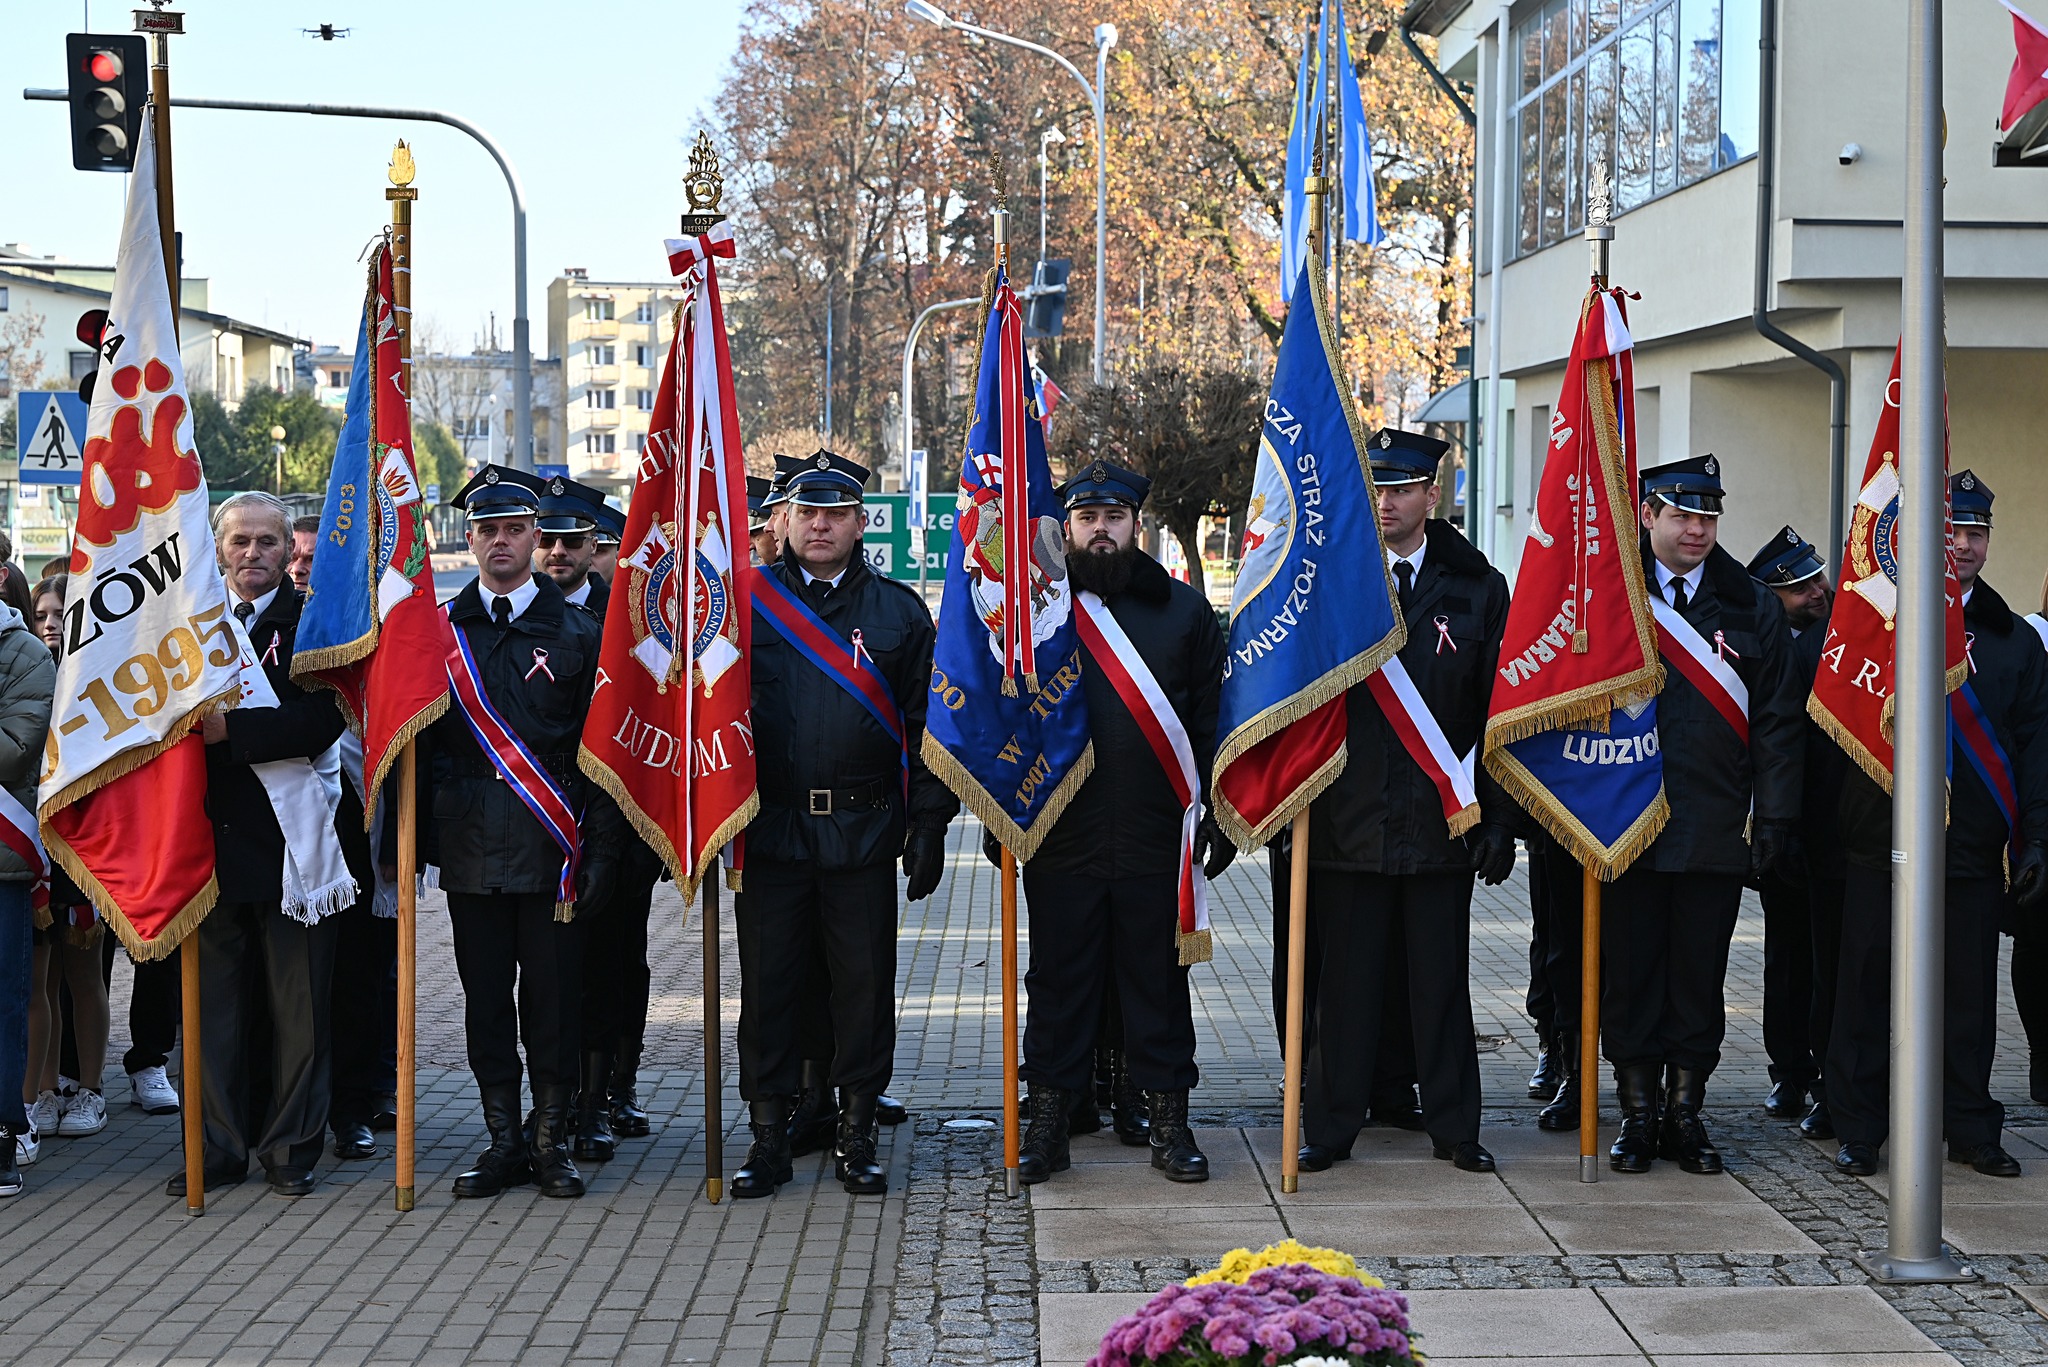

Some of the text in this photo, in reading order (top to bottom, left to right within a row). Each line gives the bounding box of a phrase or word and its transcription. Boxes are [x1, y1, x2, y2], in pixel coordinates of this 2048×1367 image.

[695, 217, 714, 225] OSP
[329, 483, 356, 547] 2003
[1876, 513, 1892, 557] STRAŻY
[1236, 453, 1326, 667] STRAŻ POŻARNA
[709, 579, 722, 593] RP
[996, 734, 1025, 765] W
[1015, 752, 1055, 810] 1907
